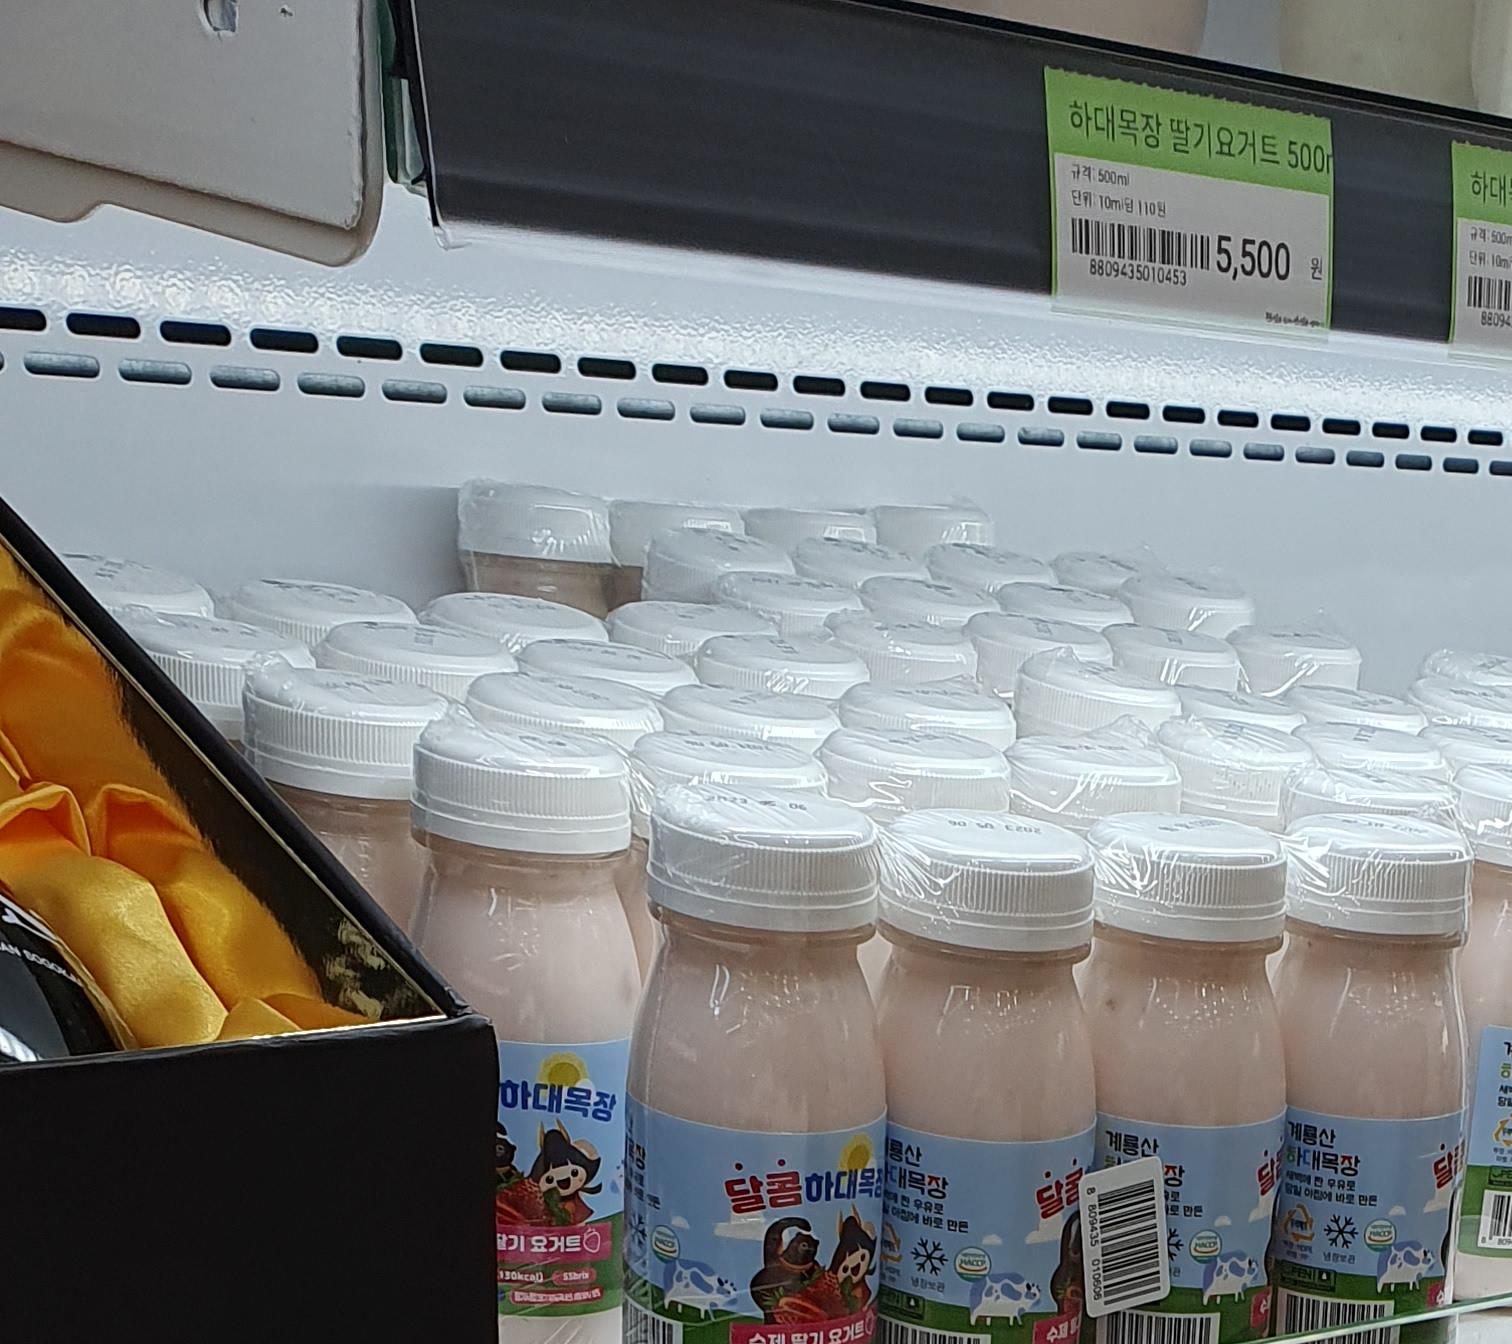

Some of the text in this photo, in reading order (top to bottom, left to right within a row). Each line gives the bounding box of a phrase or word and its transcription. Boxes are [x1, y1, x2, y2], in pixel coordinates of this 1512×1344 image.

[1069, 100, 1280, 165] 하대목장 딸기요거트
[1089, 259, 1187, 286] 8809435010453
[1216, 234, 1290, 281] 5,500
[500, 1080, 616, 1122] 하대목장
[1105, 1130, 1160, 1157] 계룡산
[1287, 1120, 1336, 1149] 계룡산
[1287, 1147, 1360, 1176] 하대목장
[724, 1158, 803, 1215] 달콤
[530, 1234, 582, 1253] 요거트
[1088, 1204, 1099, 1248] 809435
